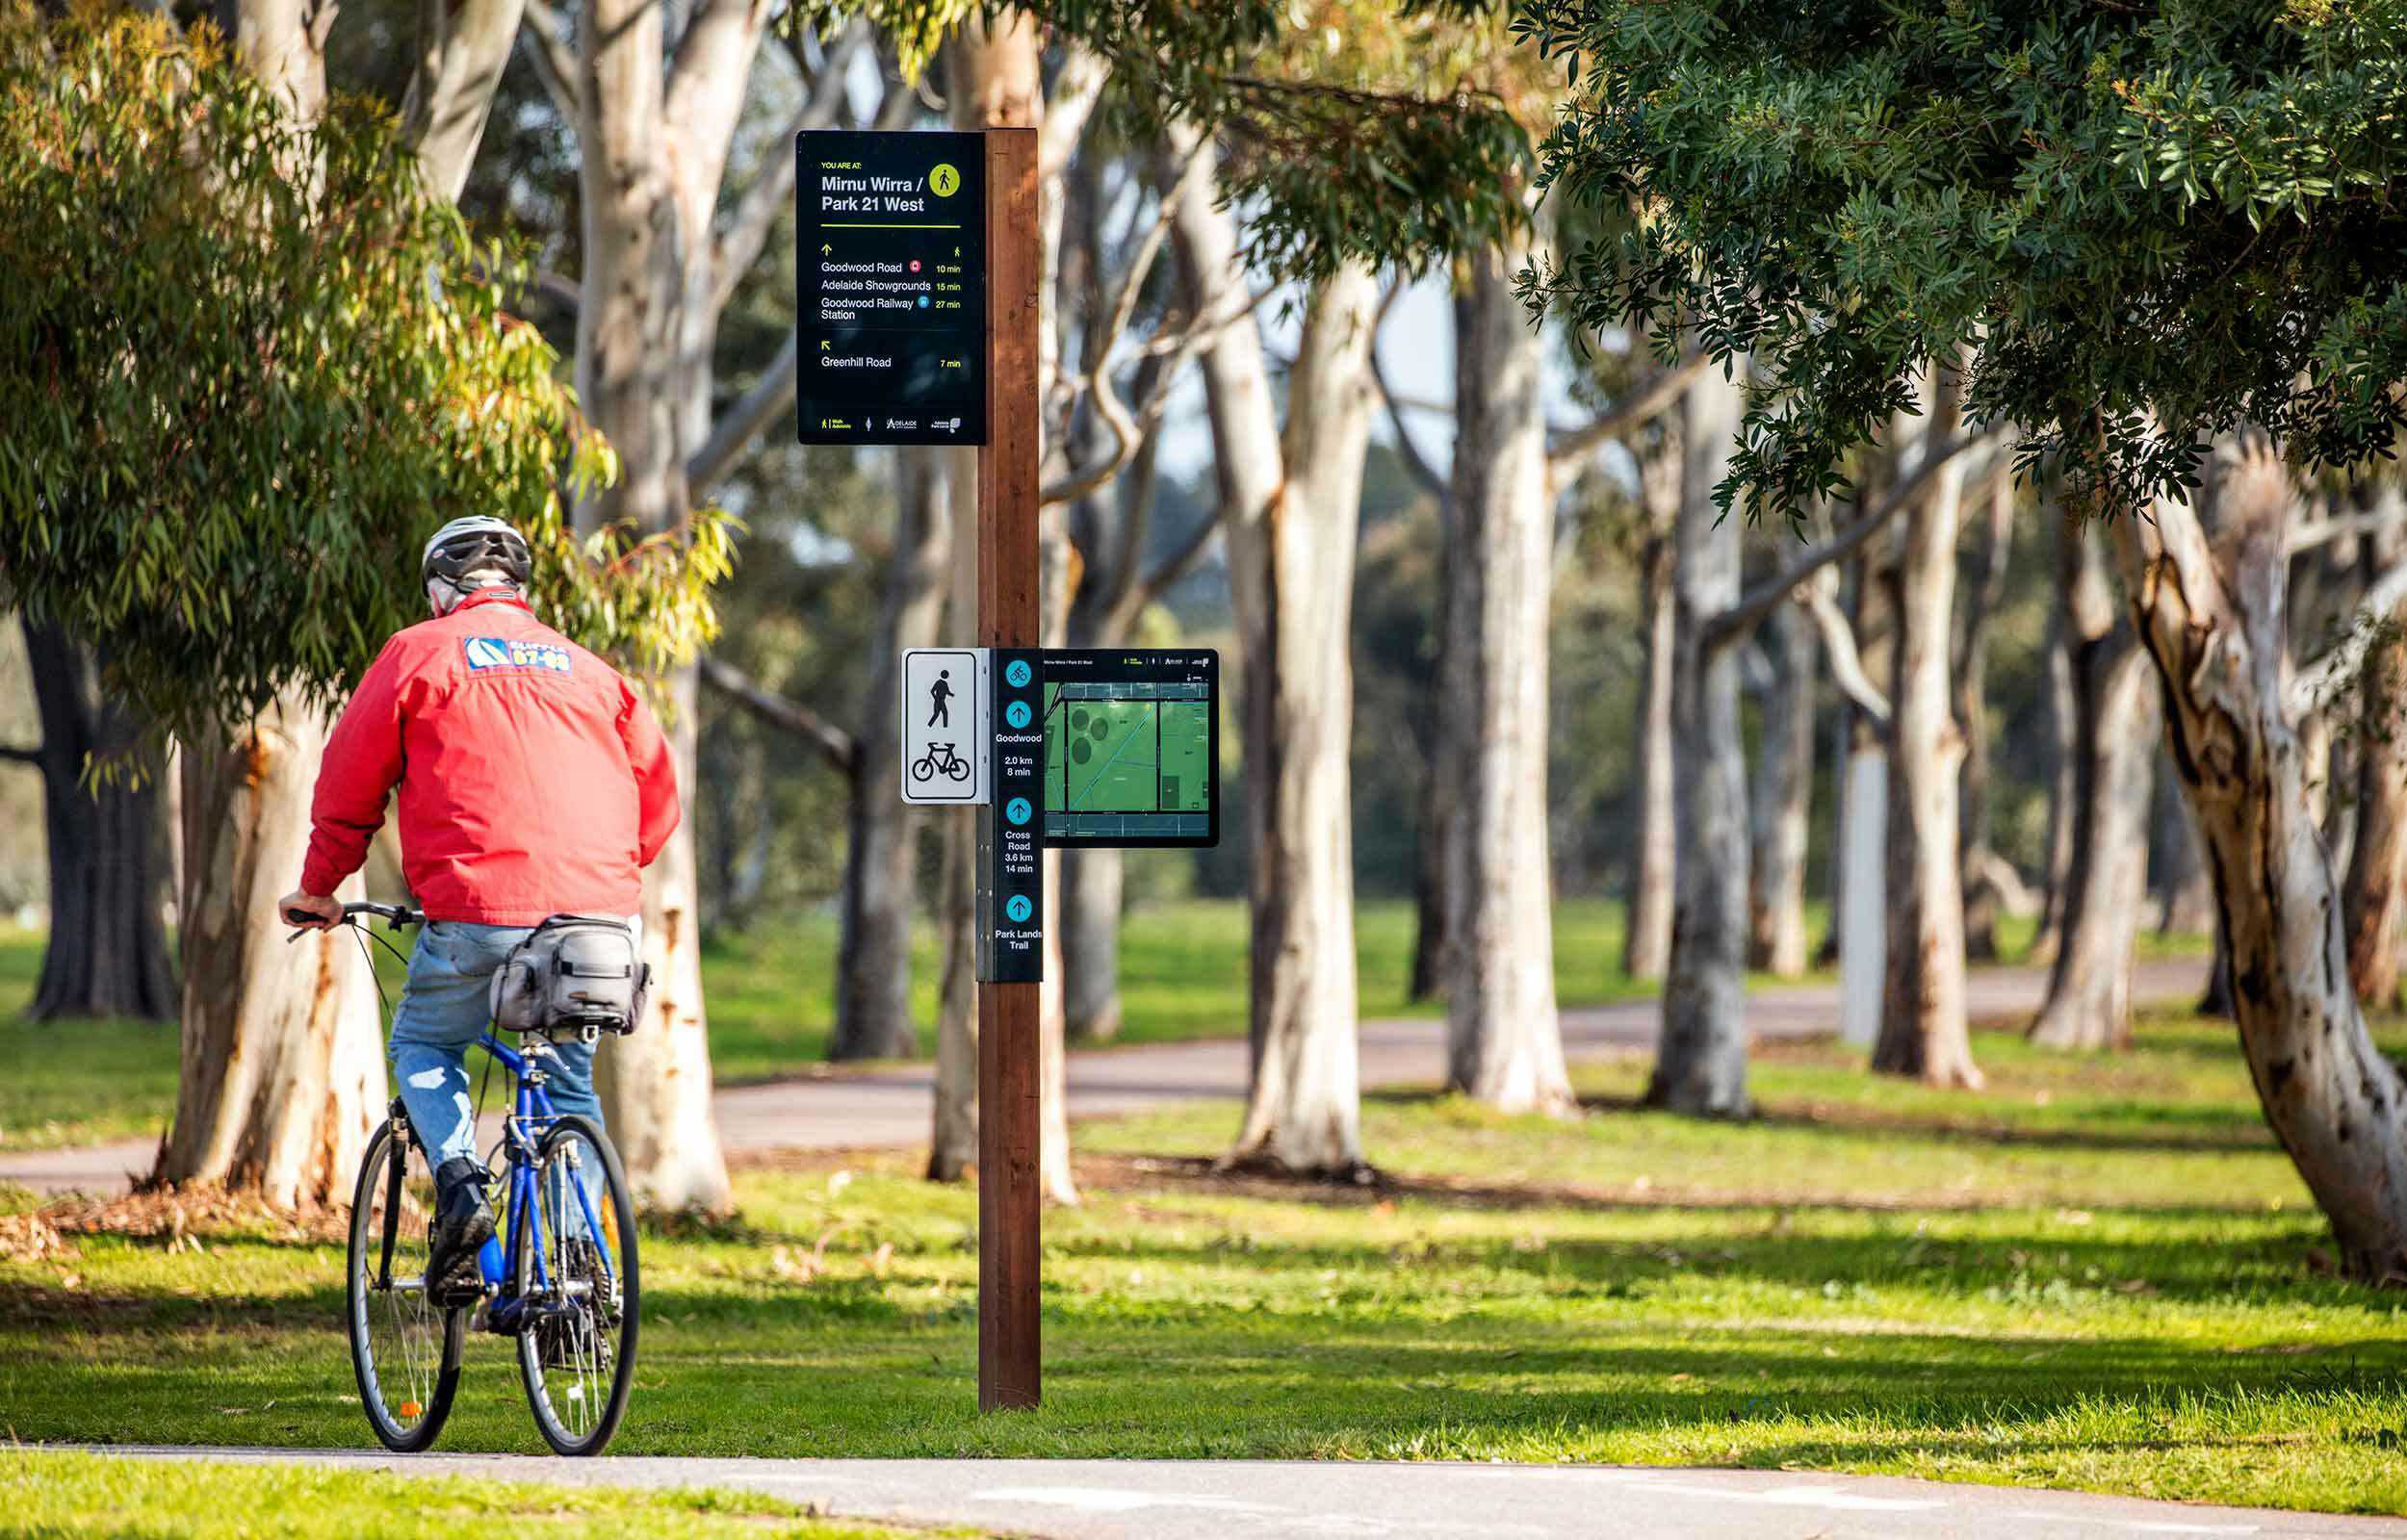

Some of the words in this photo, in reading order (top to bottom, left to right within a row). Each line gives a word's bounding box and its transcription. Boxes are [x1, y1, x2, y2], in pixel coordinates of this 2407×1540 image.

[822, 176, 866, 191] Mirnu
[871, 176, 912, 191] Wirra
[917, 177, 923, 191] /
[822, 197, 858, 211] Park
[862, 197, 879, 211] 21
[885, 197, 924, 211] West
[822, 263, 874, 272] Goodwood
[877, 263, 902, 272] Road
[822, 280, 863, 290] Adelaide
[866, 281, 931, 293] Showgrounds
[822, 298, 874, 308] Goodwood
[877, 298, 913, 311] Railway
[822, 310, 855, 320] Station
[822, 357, 863, 367] Greenhill
[867, 358, 891, 367] Road
[996, 734, 1042, 742] Goodwood
[1020, 756, 1032, 765] km
[1007, 768, 1013, 776] 8
[1015, 767, 1030, 776] min
